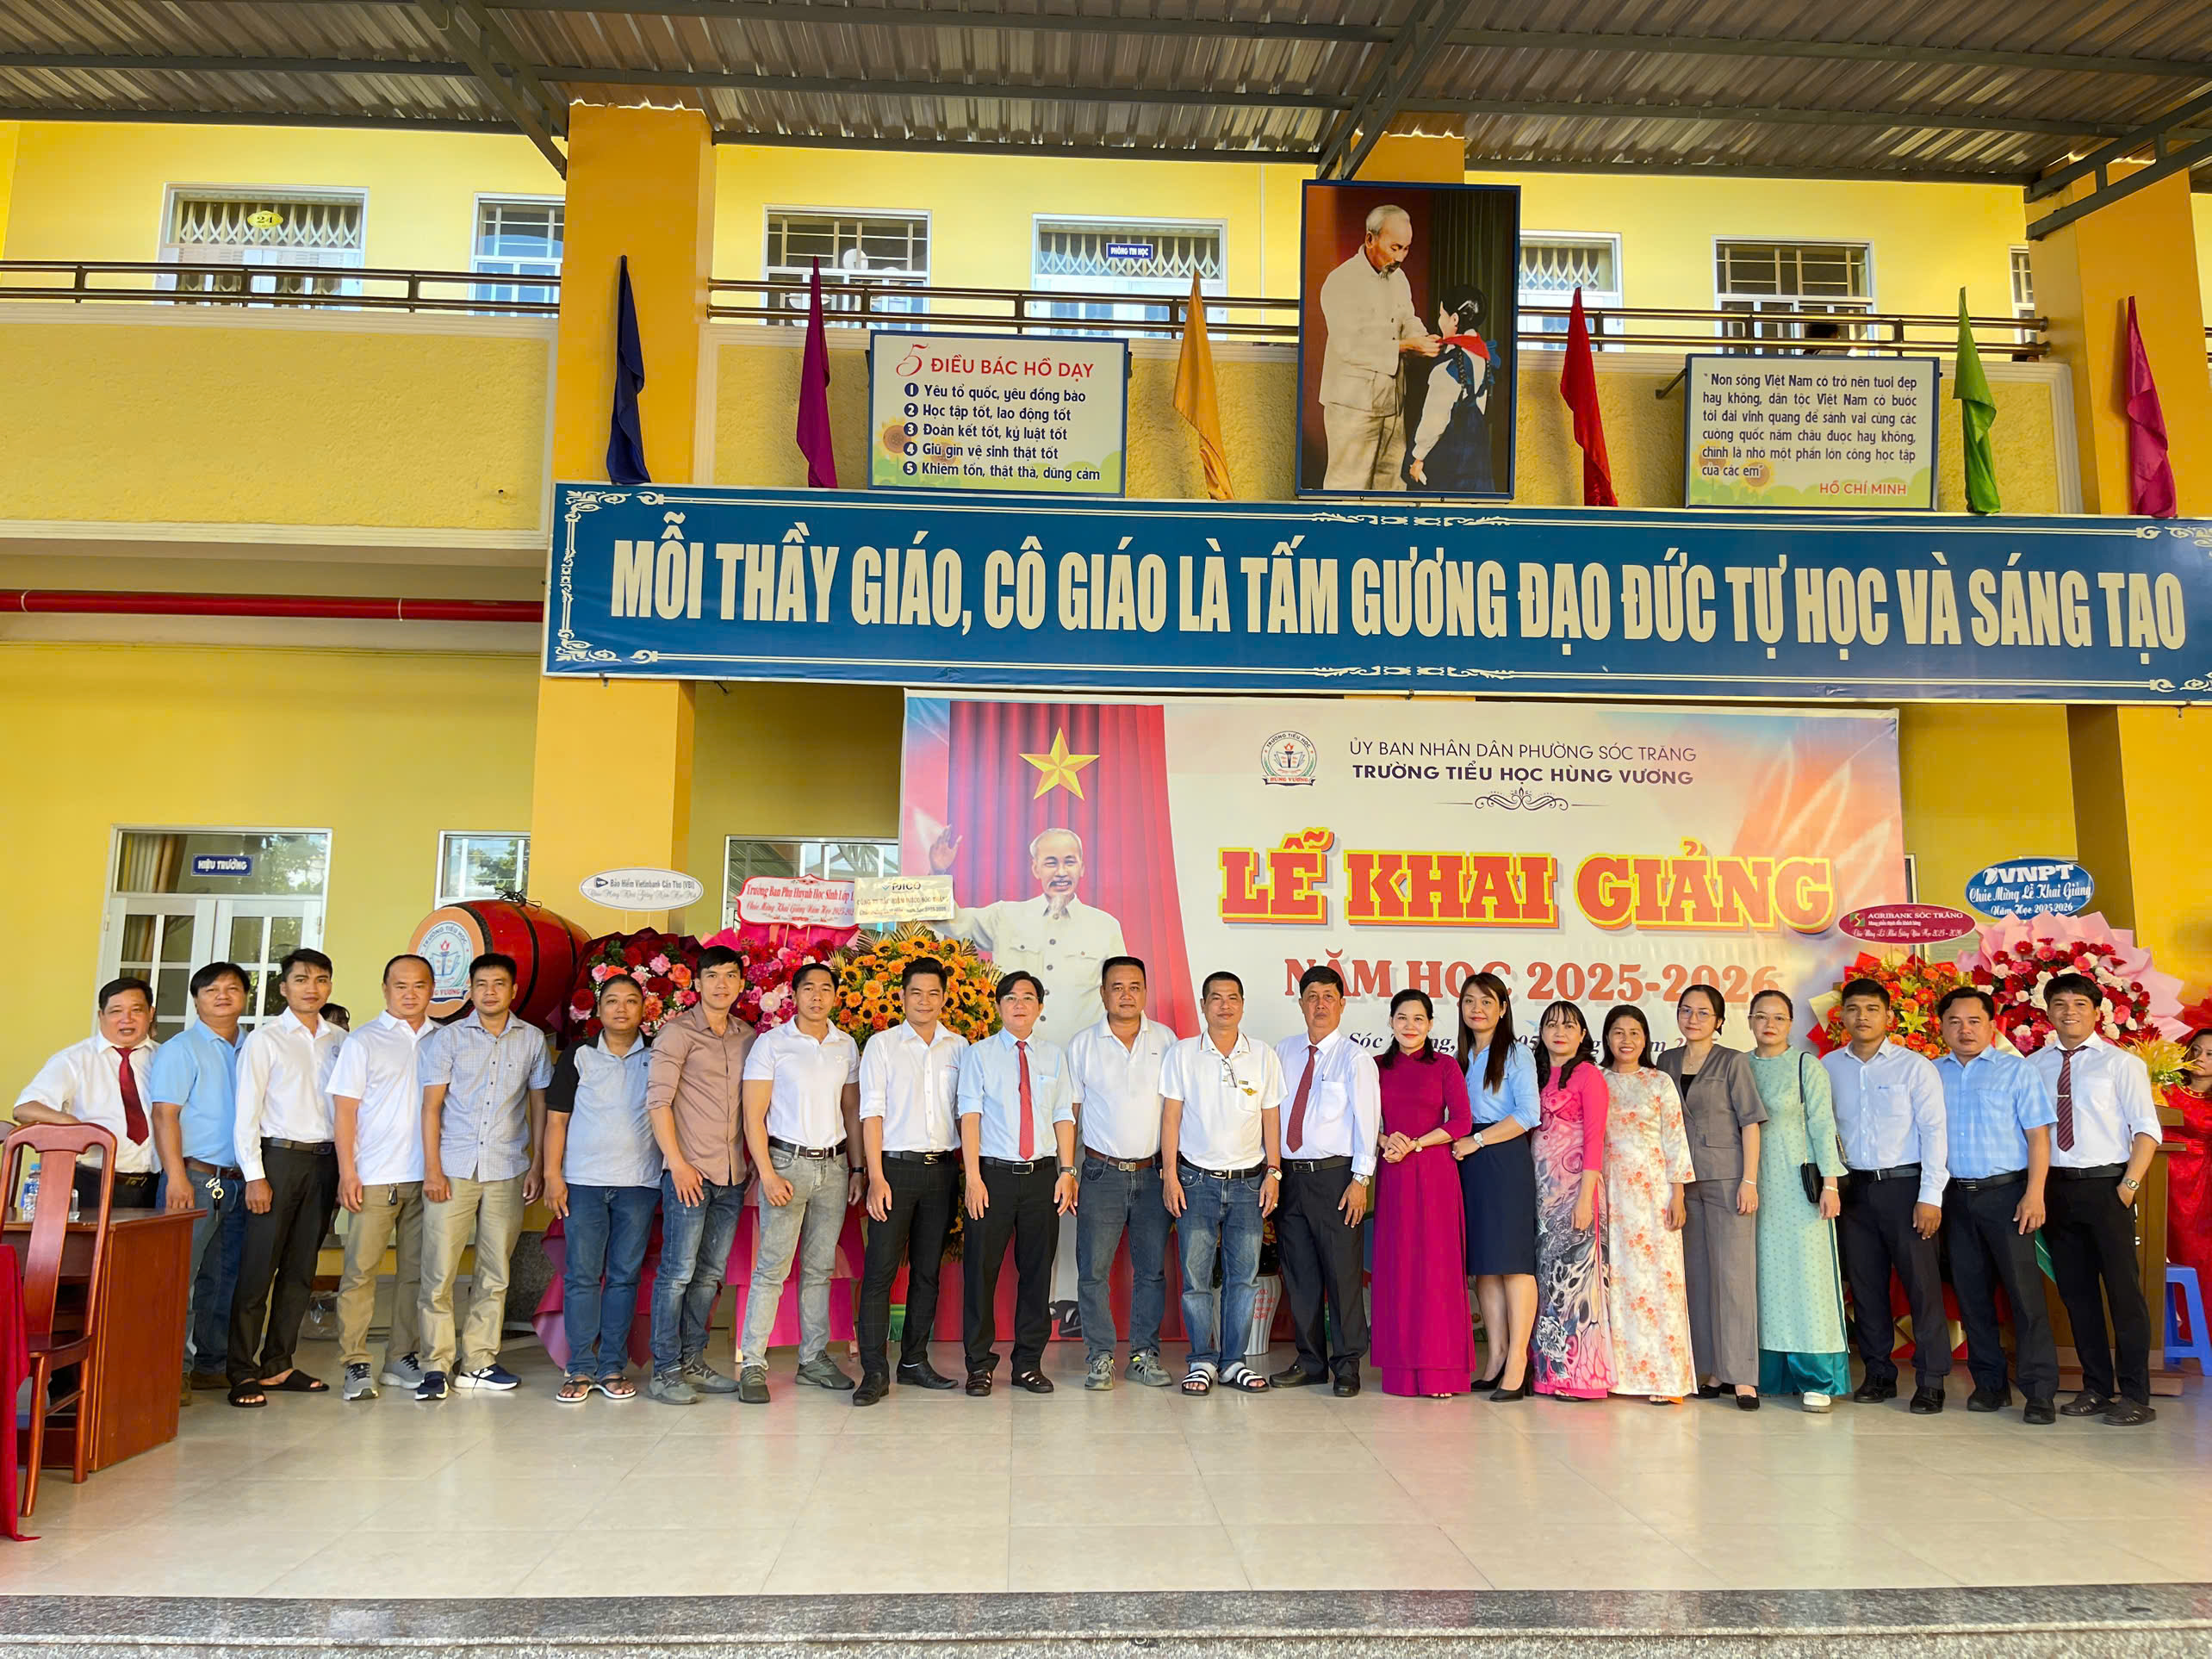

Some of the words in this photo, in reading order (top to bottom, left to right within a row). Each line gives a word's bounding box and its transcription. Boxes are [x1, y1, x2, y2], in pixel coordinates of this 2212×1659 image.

[896, 343, 929, 376] 5
[931, 354, 974, 374] ĐIỀU
[981, 356, 1018, 375] BÁC
[1023, 357, 1052, 376] HỒ
[1059, 363, 1094, 382] DẠY
[1711, 373, 1732, 385] Non
[1736, 375, 1760, 388] sông
[1765, 374, 1785, 389] Việt
[1788, 375, 1812, 387] Nam
[1851, 376, 1870, 388] nên
[1898, 376, 1917, 391] đẹp
[924, 384, 948, 397] Yêu
[952, 383, 965, 397] tổ
[968, 385, 1000, 401] quốc,
[1004, 388, 1025, 402] yêu
[1703, 392, 1721, 406] hay
[1728, 392, 1762, 407] không,
[1768, 393, 1787, 404] dân
[1793, 393, 1811, 407] tộc
[1817, 394, 1837, 408] Việt
[1843, 394, 1867, 406] Nam
[923, 404, 945, 419] Học
[950, 405, 968, 420] tập
[972, 405, 992, 419] tốt,
[997, 407, 1015, 419] lao
[1019, 407, 1049, 423] động
[1053, 407, 1072, 420] tốt
[1743, 410, 1763, 422] vinh
[1768, 413, 1800, 426] quang
[1851, 412, 1867, 424] vai
[958, 424, 977, 437] kết
[981, 424, 1001, 439] tốt,
[1023, 426, 1046, 442] luật
[1050, 426, 1067, 440] tốt
[1739, 427, 1764, 443] quốc
[1798, 430, 1821, 442] châu
[1857, 431, 1876, 445] hay
[1881, 431, 1916, 445] không,
[967, 444, 982, 459] vệ
[986, 444, 1009, 457] sinh
[1014, 446, 1036, 462] thật
[1041, 445, 1058, 459] tốt
[1770, 447, 1792, 462] một
[1846, 448, 1871, 463] công
[1875, 449, 1894, 463] học
[1899, 449, 1916, 463] tập
[922, 462, 959, 475] Khiêm
[990, 465, 1013, 480] thật
[1043, 467, 1072, 482] dũng
[1844, 481, 1867, 494] CHÍ
[1871, 483, 1906, 495] MINH
[611, 511, 704, 620] MỖI
[715, 522, 840, 623] THẦY
[851, 531, 972, 636] GIÁO,
[985, 536, 1046, 630] CÔ
[1058, 537, 1167, 632] GIÁO
[1179, 537, 1231, 632] LÀ
[1240, 535, 1338, 634] TẤM
[1351, 546, 1507, 638] GƯƠNG
[1518, 562, 1612, 656] ĐẠO
[1621, 547, 1717, 643] ĐỨC
[1724, 554, 1787, 659] TỰ
[1794, 567, 1889, 661] HỌC
[1896, 551, 1961, 644] VÀ
[1968, 552, 2092, 648] SÁNG
[2097, 572, 2186, 664] TẠO
[1350, 737, 1374, 755] ỦY
[1379, 742, 1414, 756] BAN
[1420, 739, 1471, 757] NHÂN
[1476, 740, 1514, 758] DÂN
[1519, 742, 1594, 760] PHƯỜNG
[1599, 743, 1634, 761] SÓC
[1638, 745, 1697, 762] TRĂNG
[1352, 761, 1440, 780] TRƯỜNG
[1445, 760, 1492, 780] TIỂU
[1500, 767, 1544, 785] HỌC
[1550, 765, 1612, 783] HÙNG
[1619, 768, 1693, 785] VƯƠNG
[1218, 827, 1334, 924] LỄ
[1344, 849, 1559, 929] KHAI
[1574, 836, 1836, 932] GIẢNG
[1998, 864, 2074, 883] VNPT
[1914, 910, 1931, 919] SÓC
[1526, 961, 1780, 1002] 2025-2026
[1349, 1032, 1383, 1049] Sóc
